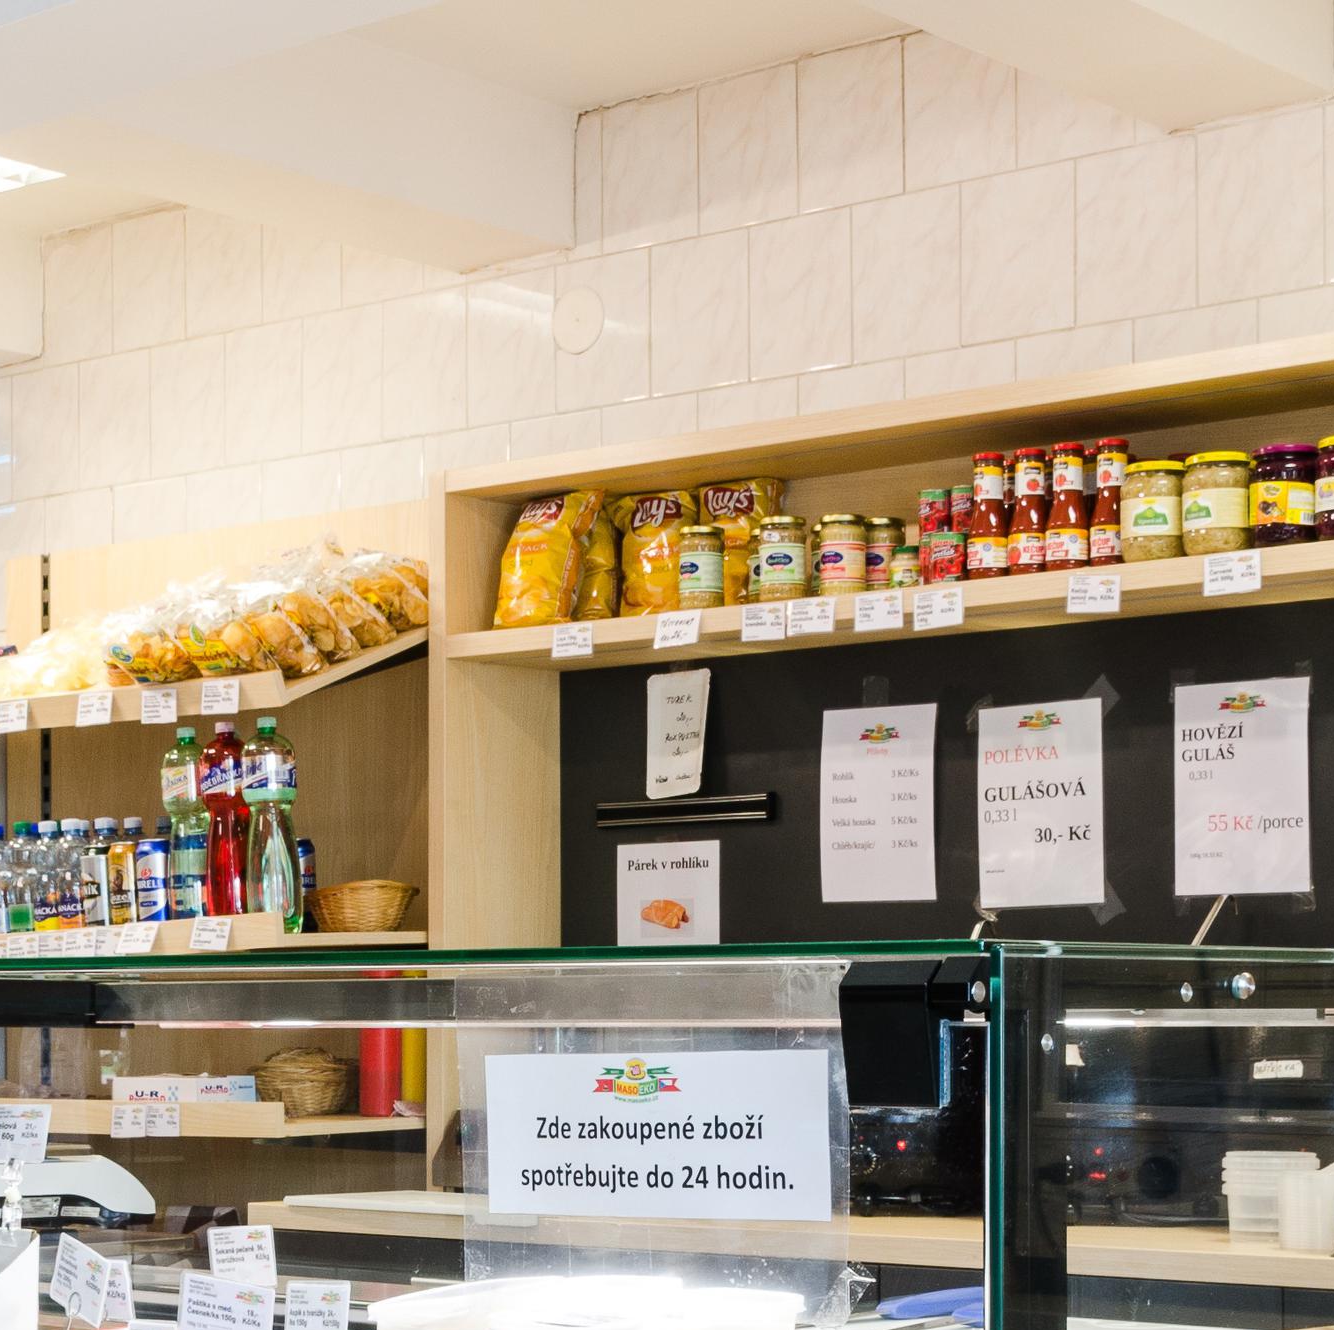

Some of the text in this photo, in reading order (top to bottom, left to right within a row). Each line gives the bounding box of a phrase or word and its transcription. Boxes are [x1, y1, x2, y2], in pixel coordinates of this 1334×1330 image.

[1181, 721, 1244, 742] HOVĚZÍ
[984, 745, 1059, 765] POLÉVKA
[1181, 744, 1236, 763] GULÁŠ
[1188, 770, 1209, 782] 0,33
[984, 776, 1086, 802] GULÁŠOVÁ
[984, 808, 1010, 824] 0,33
[1207, 814, 1304, 834] 55 Kč /porce
[1034, 824, 1092, 845] 30,- Kč
[627, 857, 709, 872] Párek v rohlíku
[537, 1114, 764, 1145] Zde zakoupené zboží
[521, 1163, 794, 1194] spotřebujte do 24 hodin.
[188, 1298, 211, 1309] Paštika
